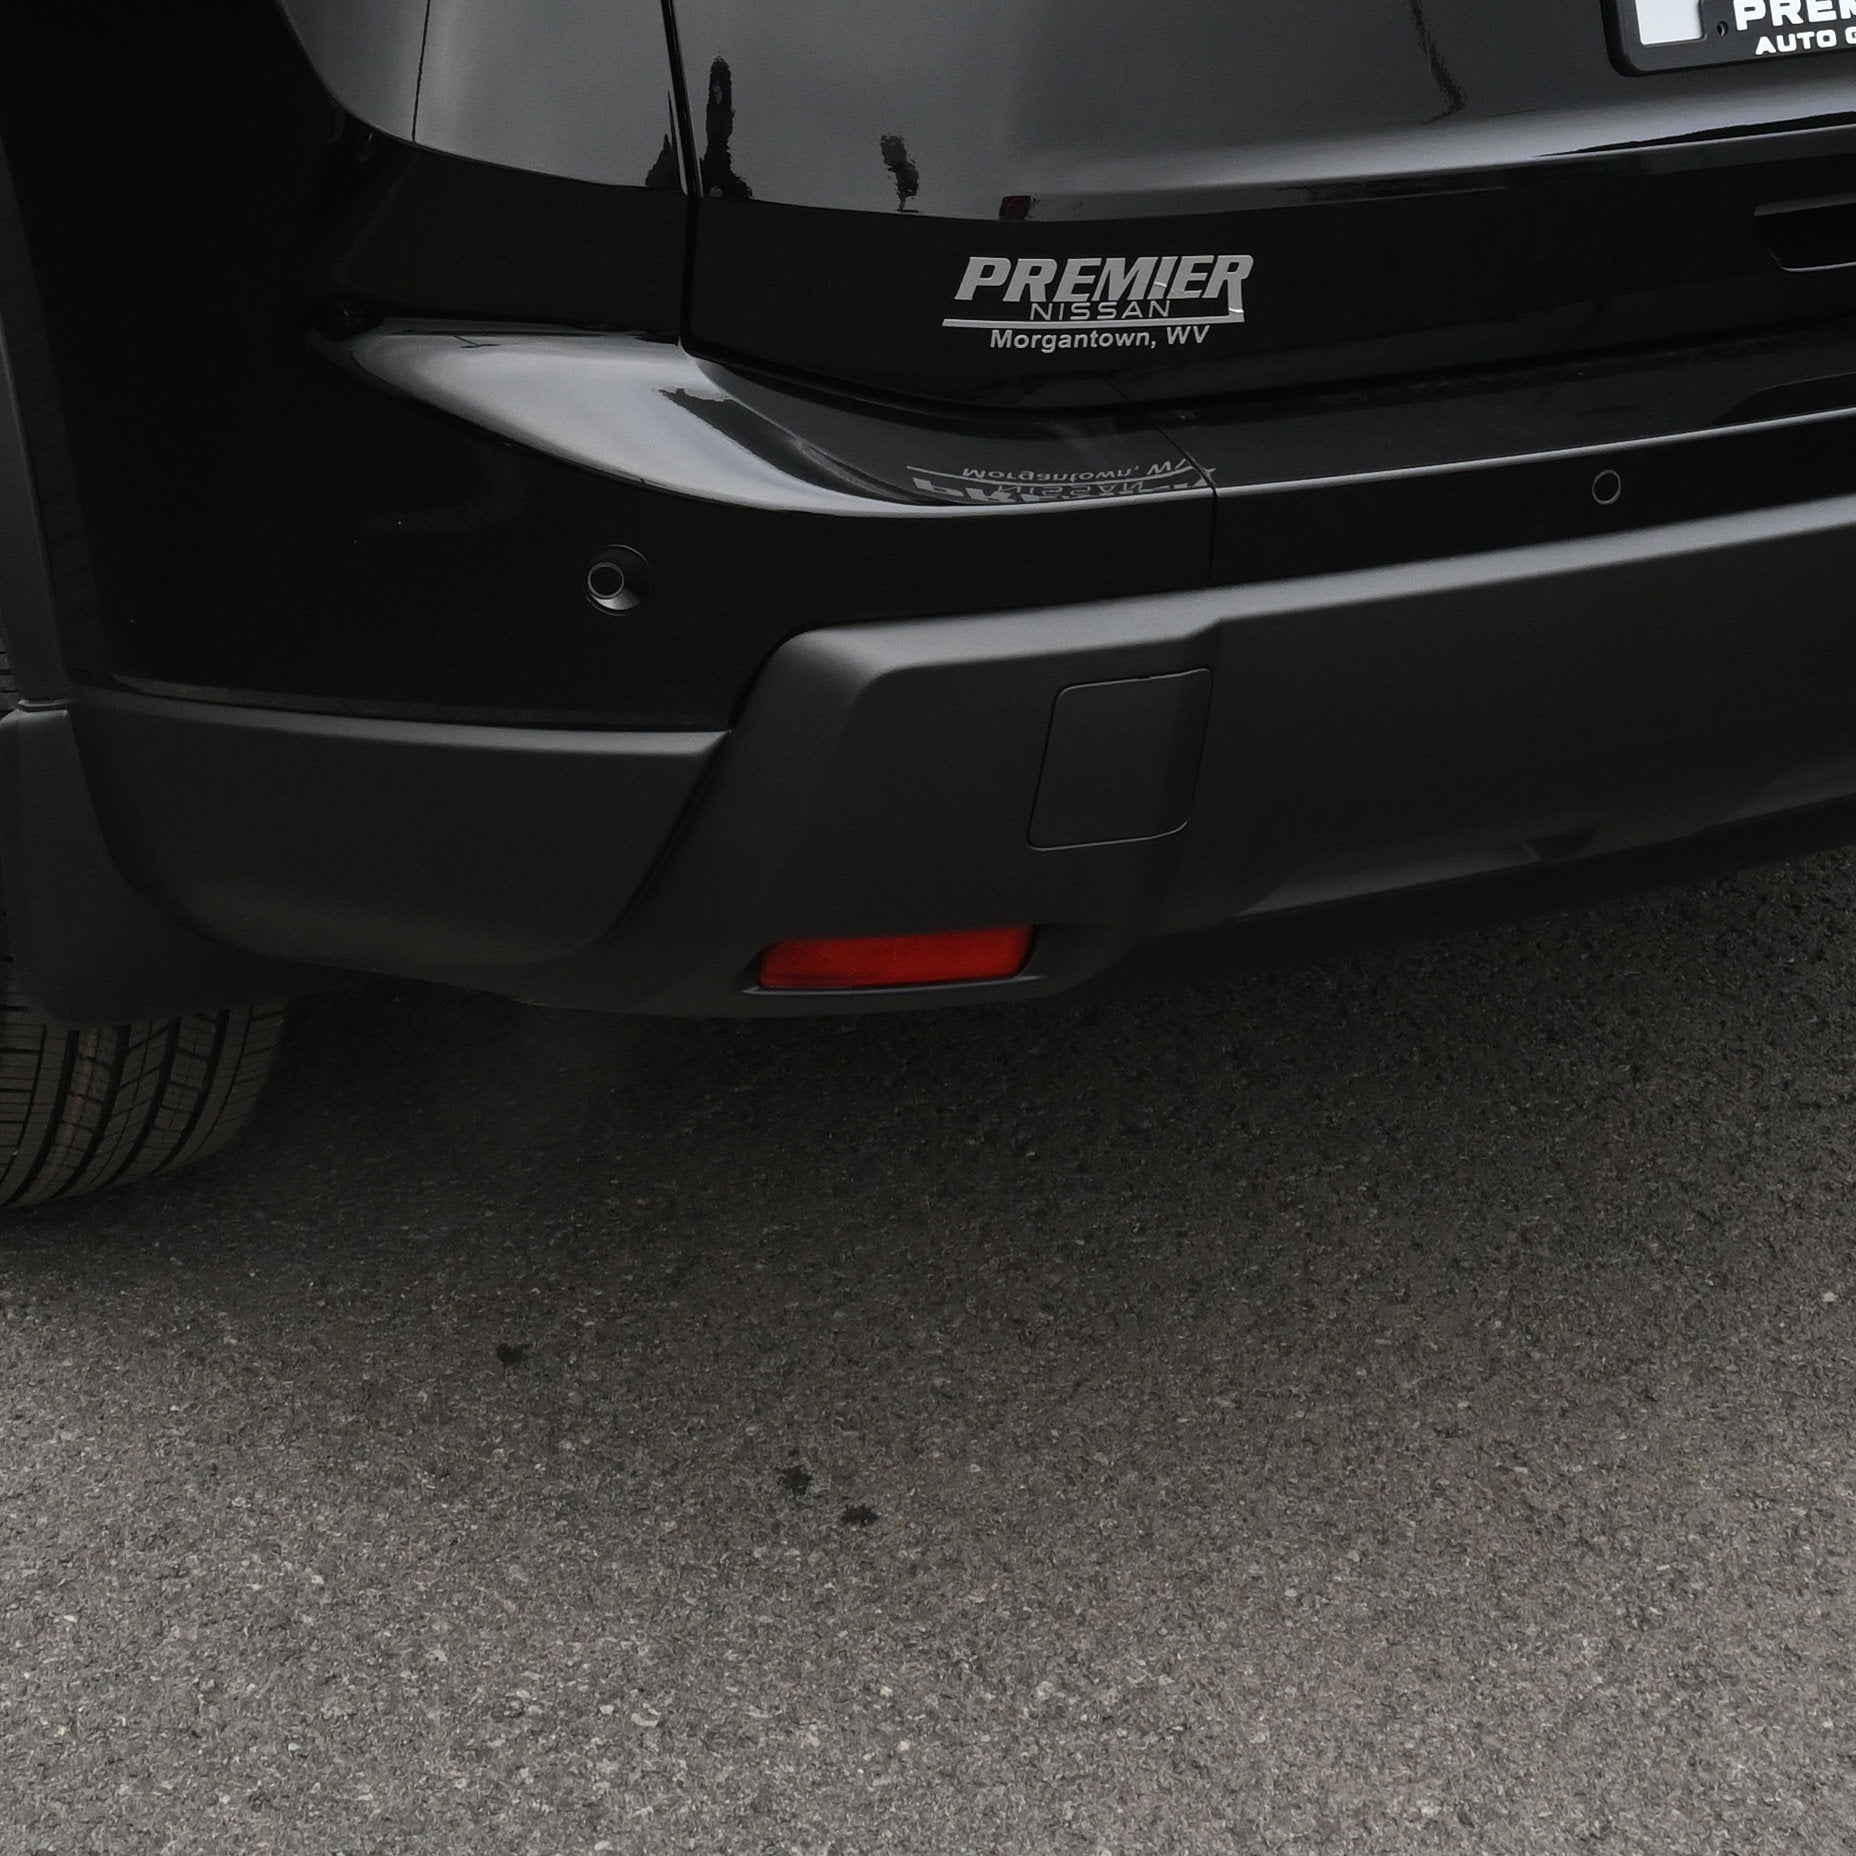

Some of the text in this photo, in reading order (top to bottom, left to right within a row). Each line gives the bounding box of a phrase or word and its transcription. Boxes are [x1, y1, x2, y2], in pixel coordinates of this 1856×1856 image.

[1755, 31, 1837, 56] AUTO
[954, 254, 1254, 304] PREMIER
[1030, 300, 1171, 321] NISSAN
[990, 325, 1211, 353] Morgantown, WV
